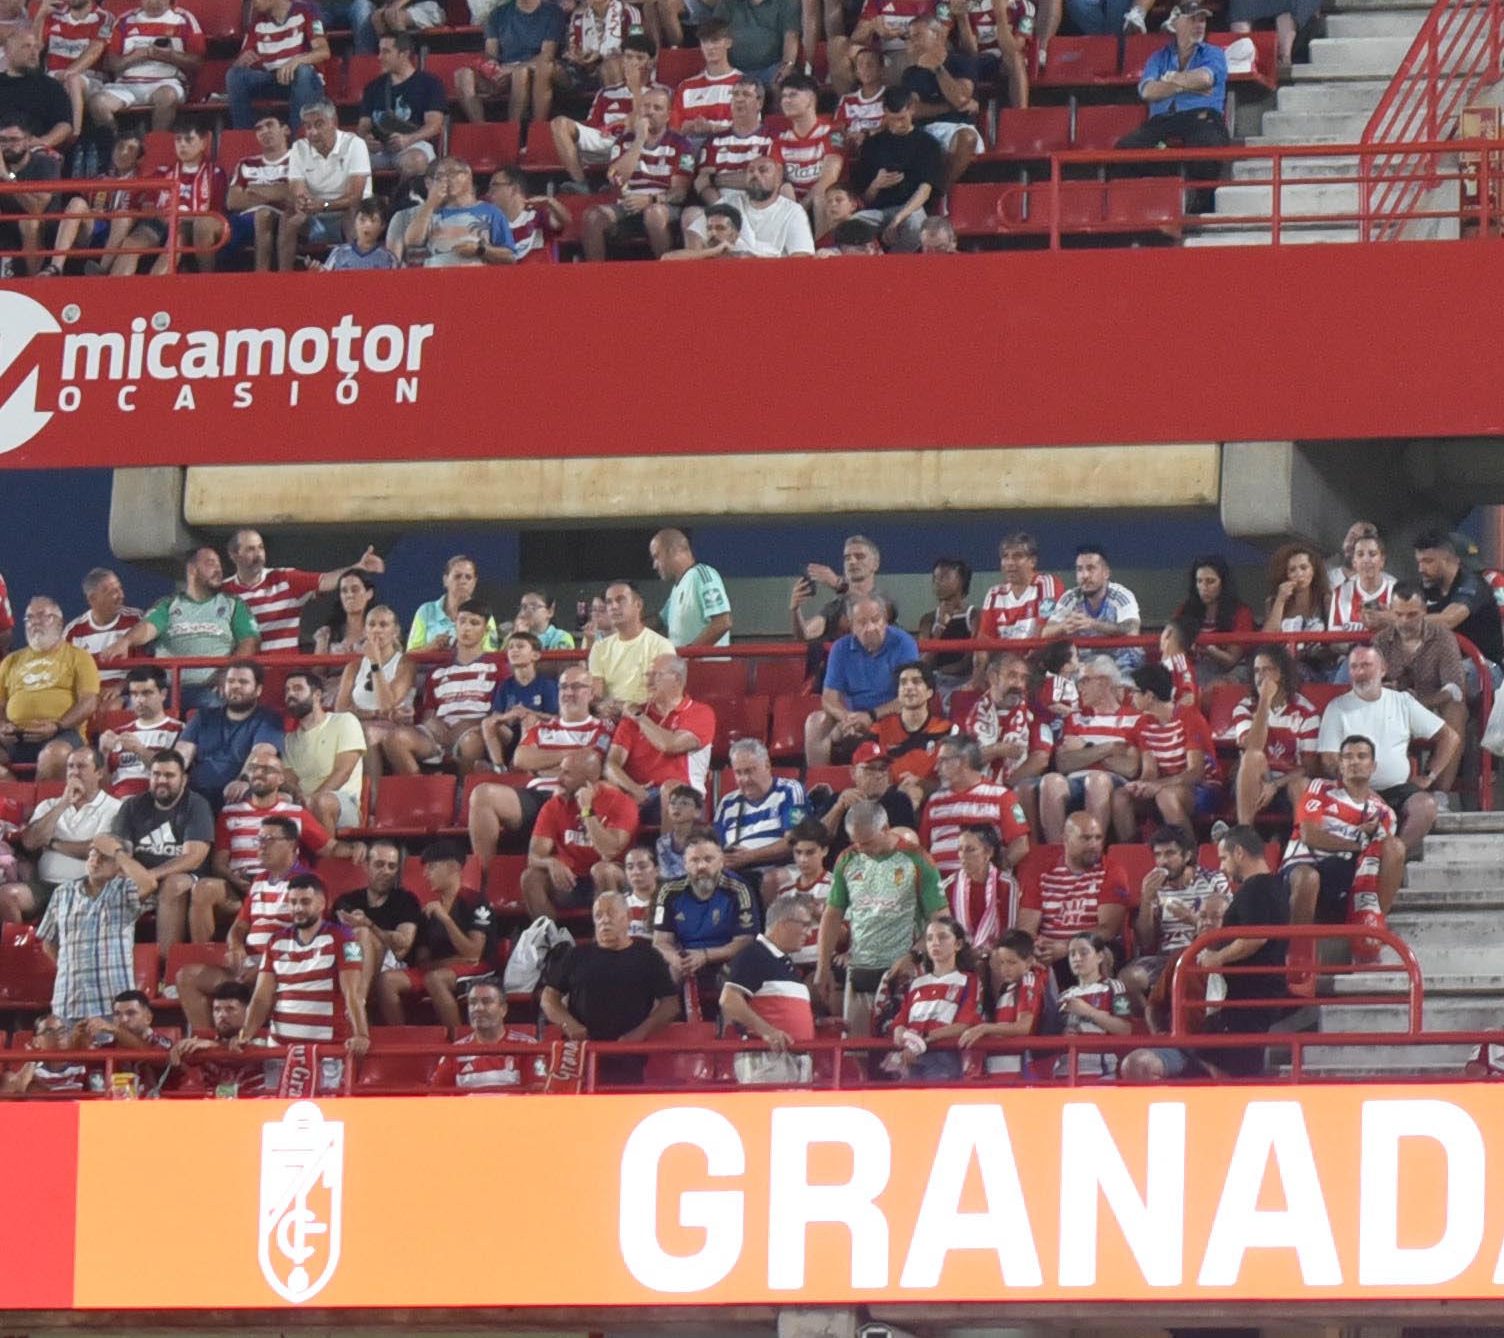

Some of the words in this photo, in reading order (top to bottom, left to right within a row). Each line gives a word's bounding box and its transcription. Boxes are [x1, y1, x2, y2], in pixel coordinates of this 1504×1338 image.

[61, 315, 435, 381] micamotor
[58, 372, 420, 413] OCASIÓN
[133, 842, 186, 858] adidas
